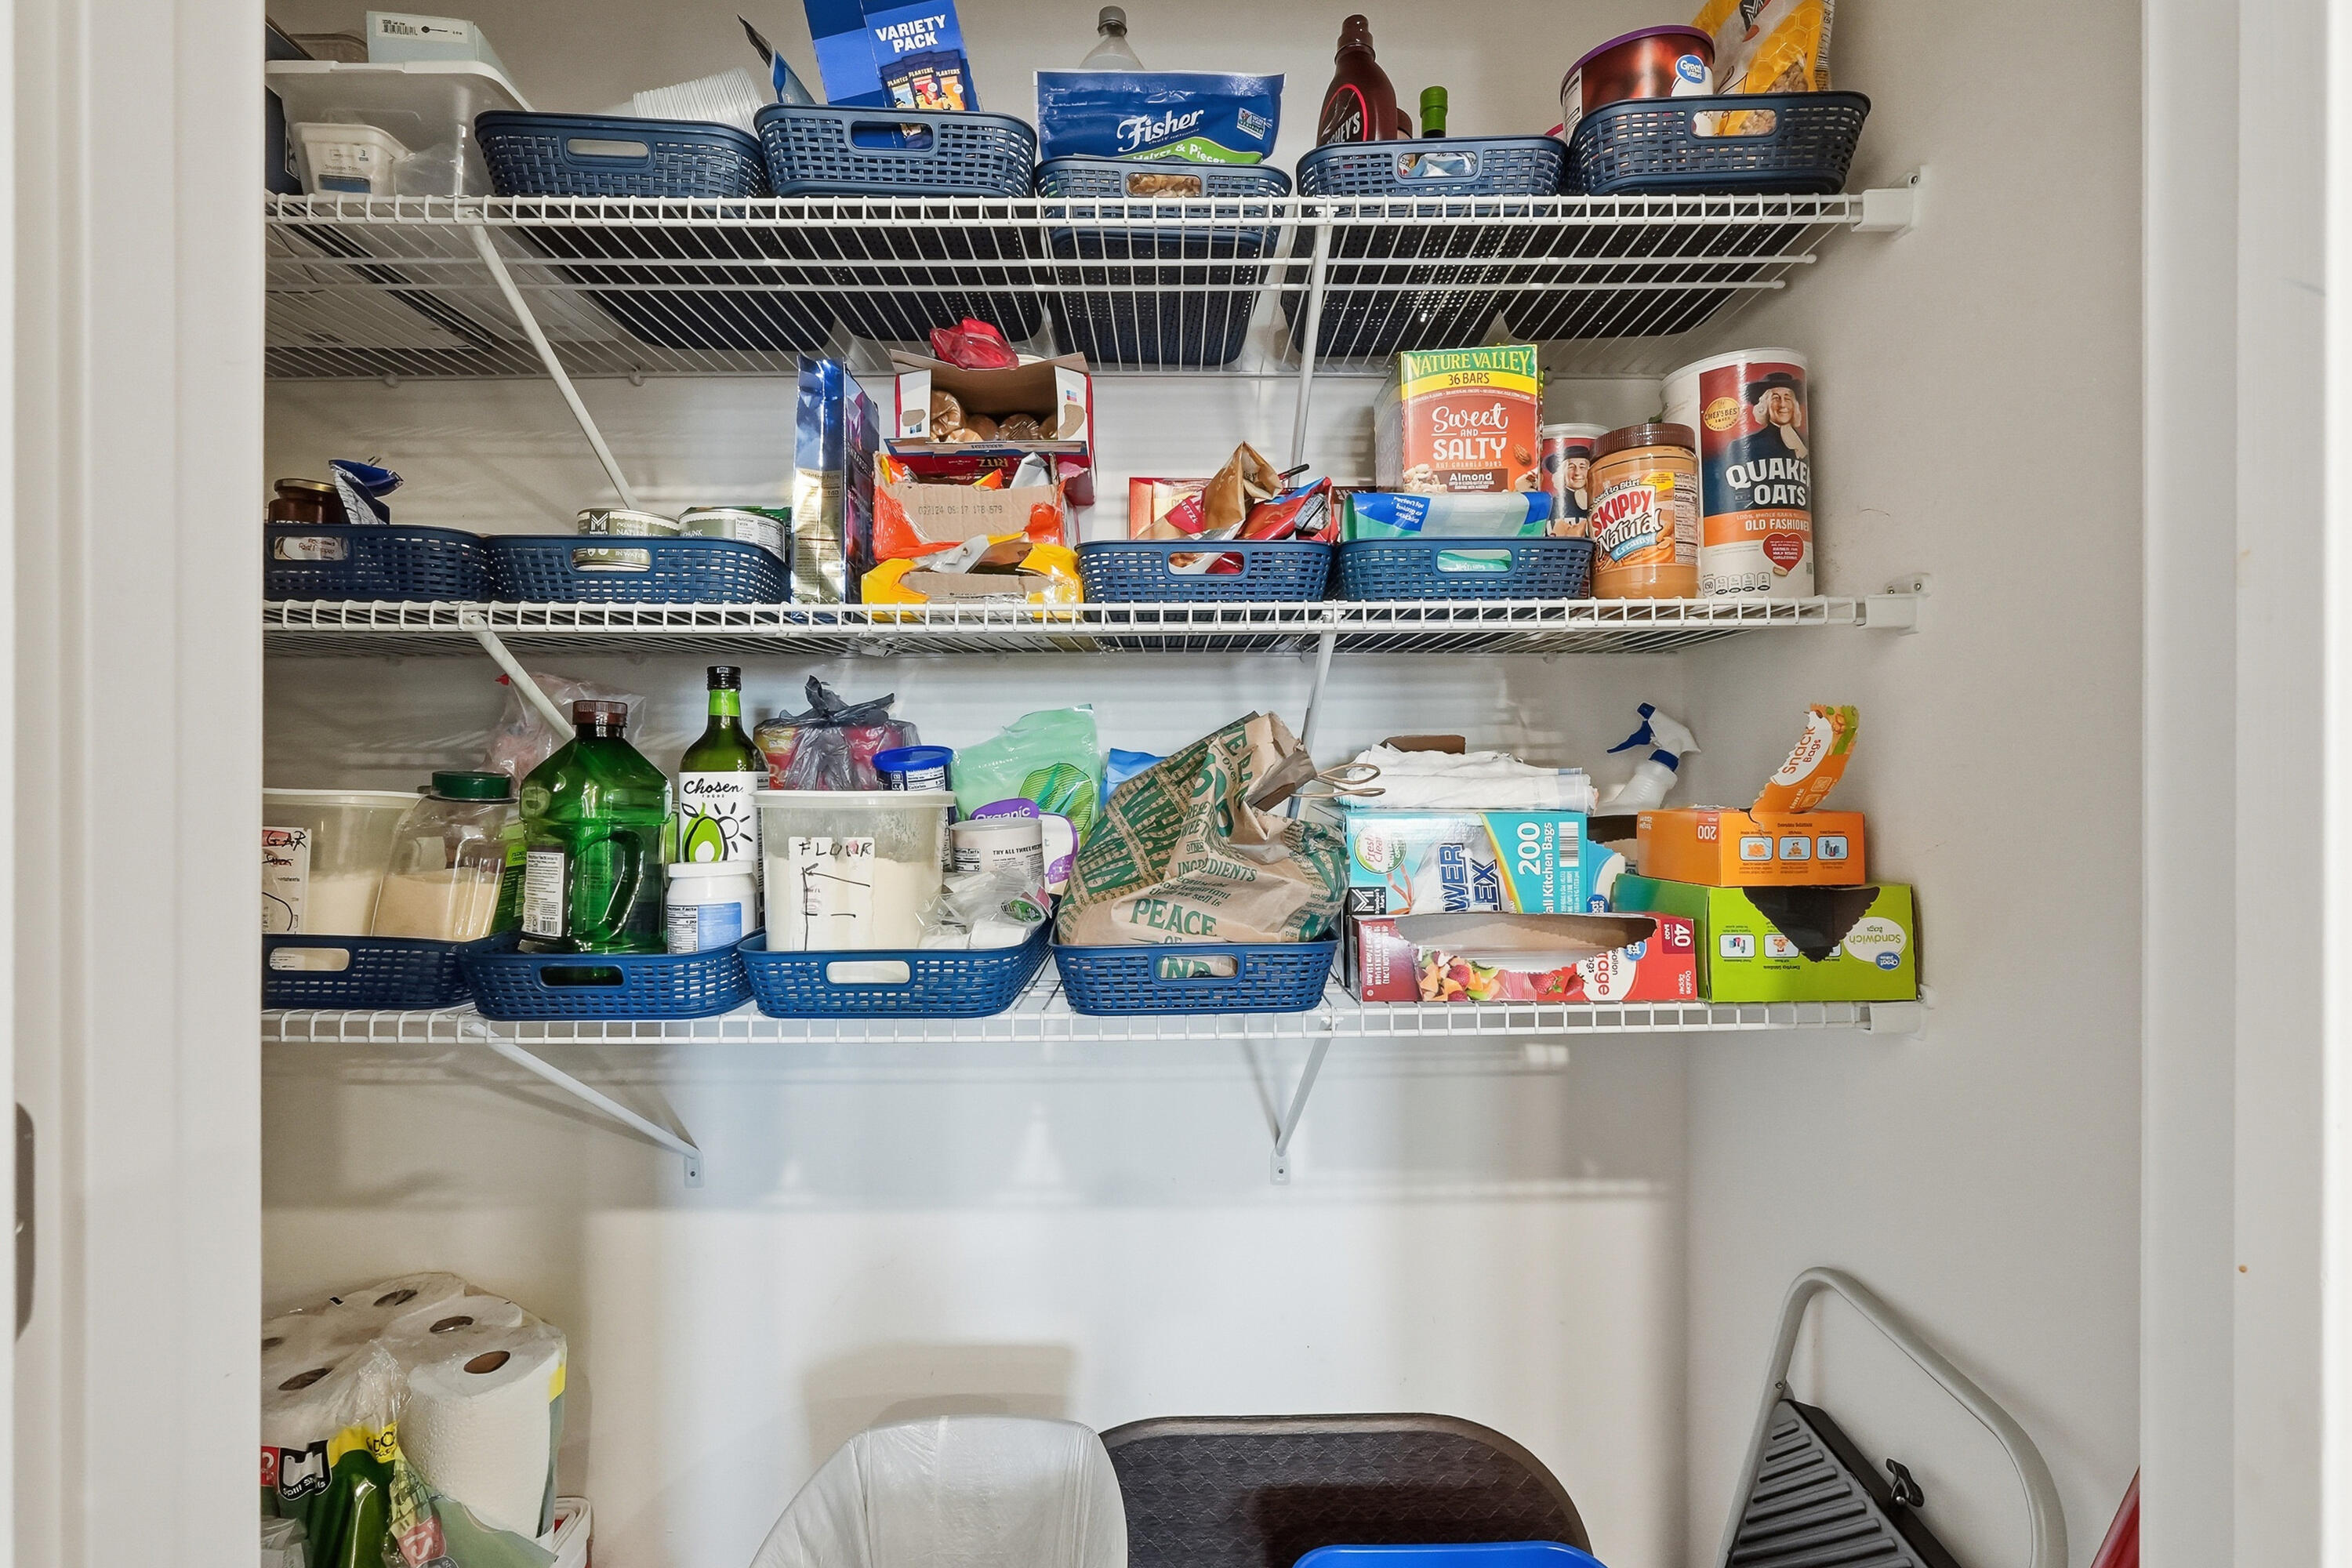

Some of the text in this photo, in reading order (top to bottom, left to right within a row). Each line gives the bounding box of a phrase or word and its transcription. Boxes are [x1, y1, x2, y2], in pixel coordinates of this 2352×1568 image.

[875, 14, 946, 42] VARIETY
[892, 31, 938, 53] PACK
[935, 68, 960, 78] PLANTERS
[1680, 60, 1702, 73] Great
[1117, 108, 1204, 153] Fisher
[1407, 350, 1532, 379] NATURE VALLEY
[1448, 372, 1490, 386] 36 BARS
[1432, 402, 1509, 433] Sweet
[1432, 437, 1507, 461] SALTY
[977, 458, 1008, 467] RITZ
[1449, 472, 1493, 481] Almond
[1754, 484, 1806, 506] OATS
[1591, 490, 1652, 537] SKIPPY
[1595, 508, 1663, 562] Natural
[1745, 520, 1766, 531] OLD
[1616, 535, 1652, 557] Creamy
[1782, 726, 1816, 775] Snack
[1802, 739, 1821, 763] Bags
[684, 778, 743, 794] Chosen
[267, 830, 307, 851] GAR
[1697, 825, 1717, 840] 200
[798, 840, 873, 858] FLOUR
[1517, 822, 1541, 876] 200
[1438, 842, 1469, 913] WER
[1541, 822, 1555, 913] all Kitchen Bags
[1192, 892, 1212, 904] sell
[1211, 898, 1221, 907] is
[1129, 898, 1218, 937] PEACE
[1675, 924, 1691, 947] 40
[1849, 935, 1901, 945] Sandwich
[1595, 953, 1610, 996] rage
